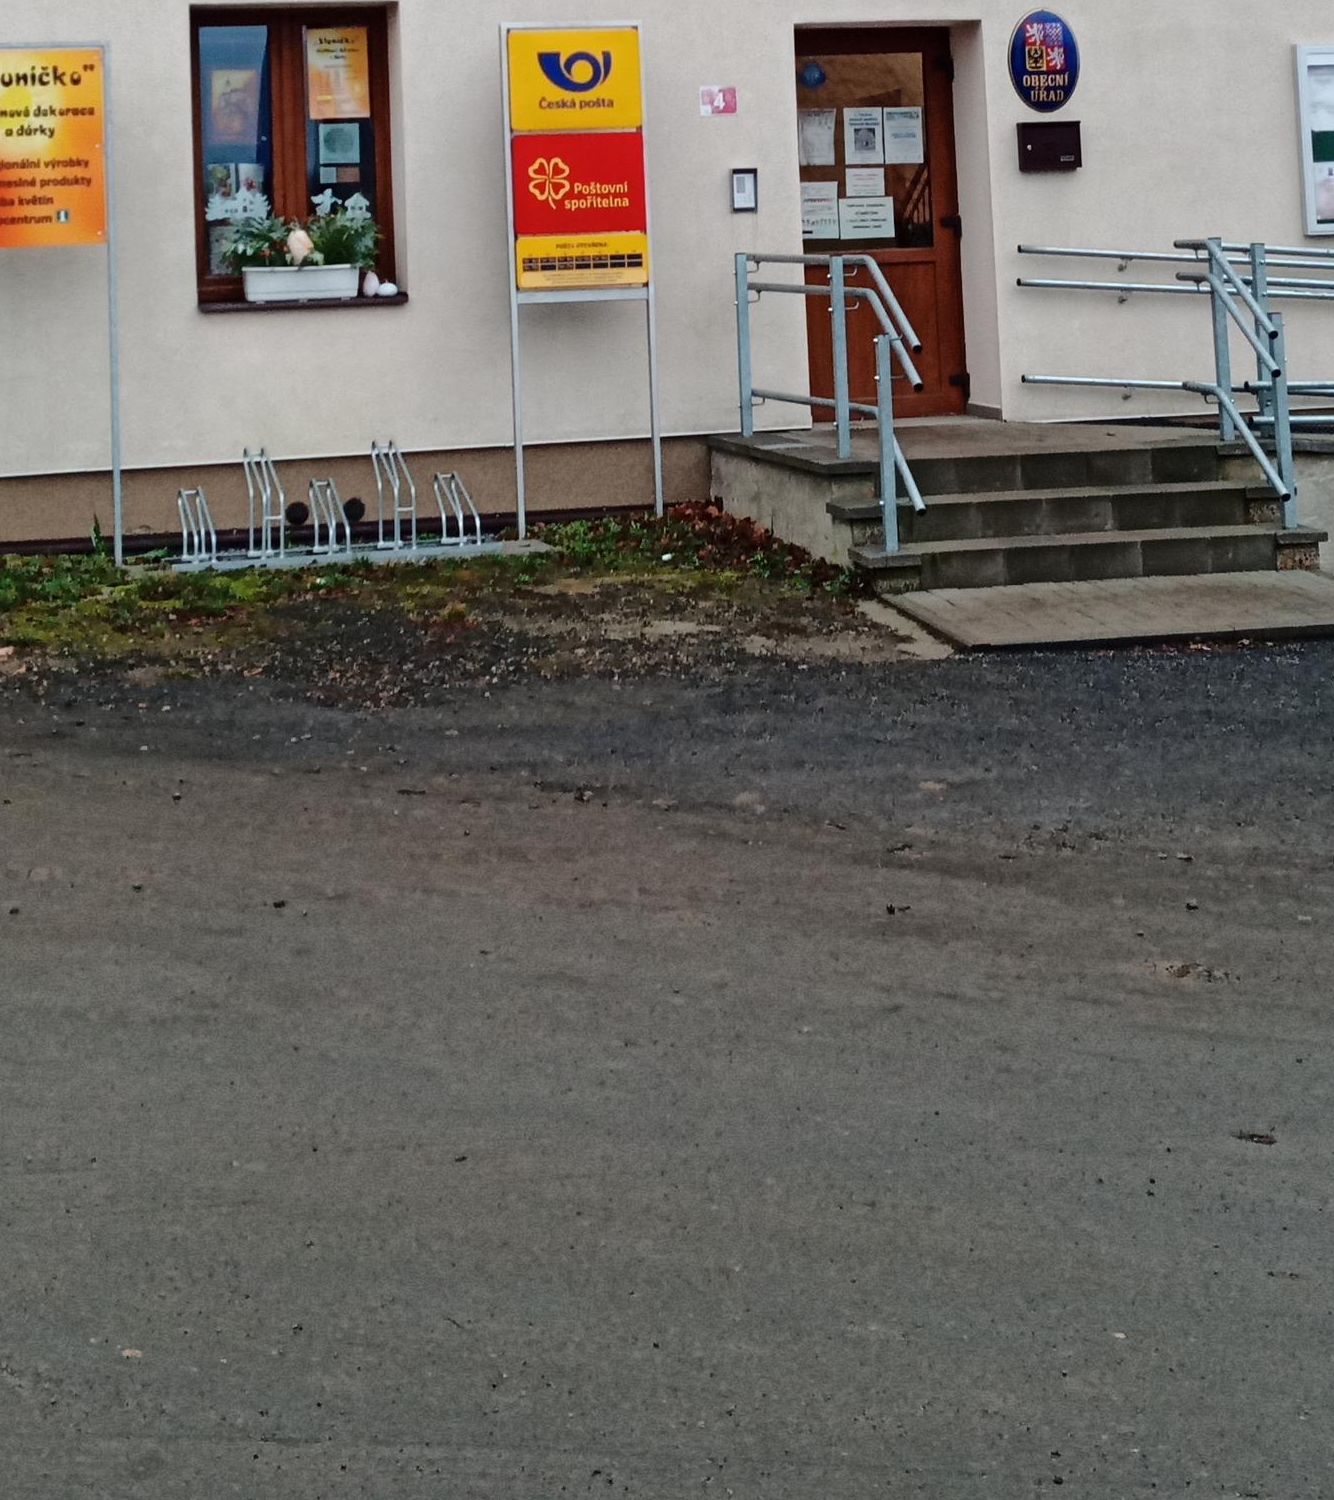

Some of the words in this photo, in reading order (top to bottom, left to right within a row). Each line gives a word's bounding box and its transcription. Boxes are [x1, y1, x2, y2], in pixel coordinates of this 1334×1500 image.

[1023, 72, 1068, 86] OBECNÍ
[1031, 86, 1064, 101] ÚŘAD
[539, 97, 576, 109] Česká
[579, 97, 615, 110] pošta
[713, 91, 726, 110] 4
[5, 128, 14, 137] a
[16, 125, 55, 139] dárky
[43, 156, 90, 169] výrobky
[39, 175, 92, 188] produkty
[573, 181, 628, 194] Poštovní
[18, 195, 54, 206] květin
[564, 195, 629, 211] spořitelna
